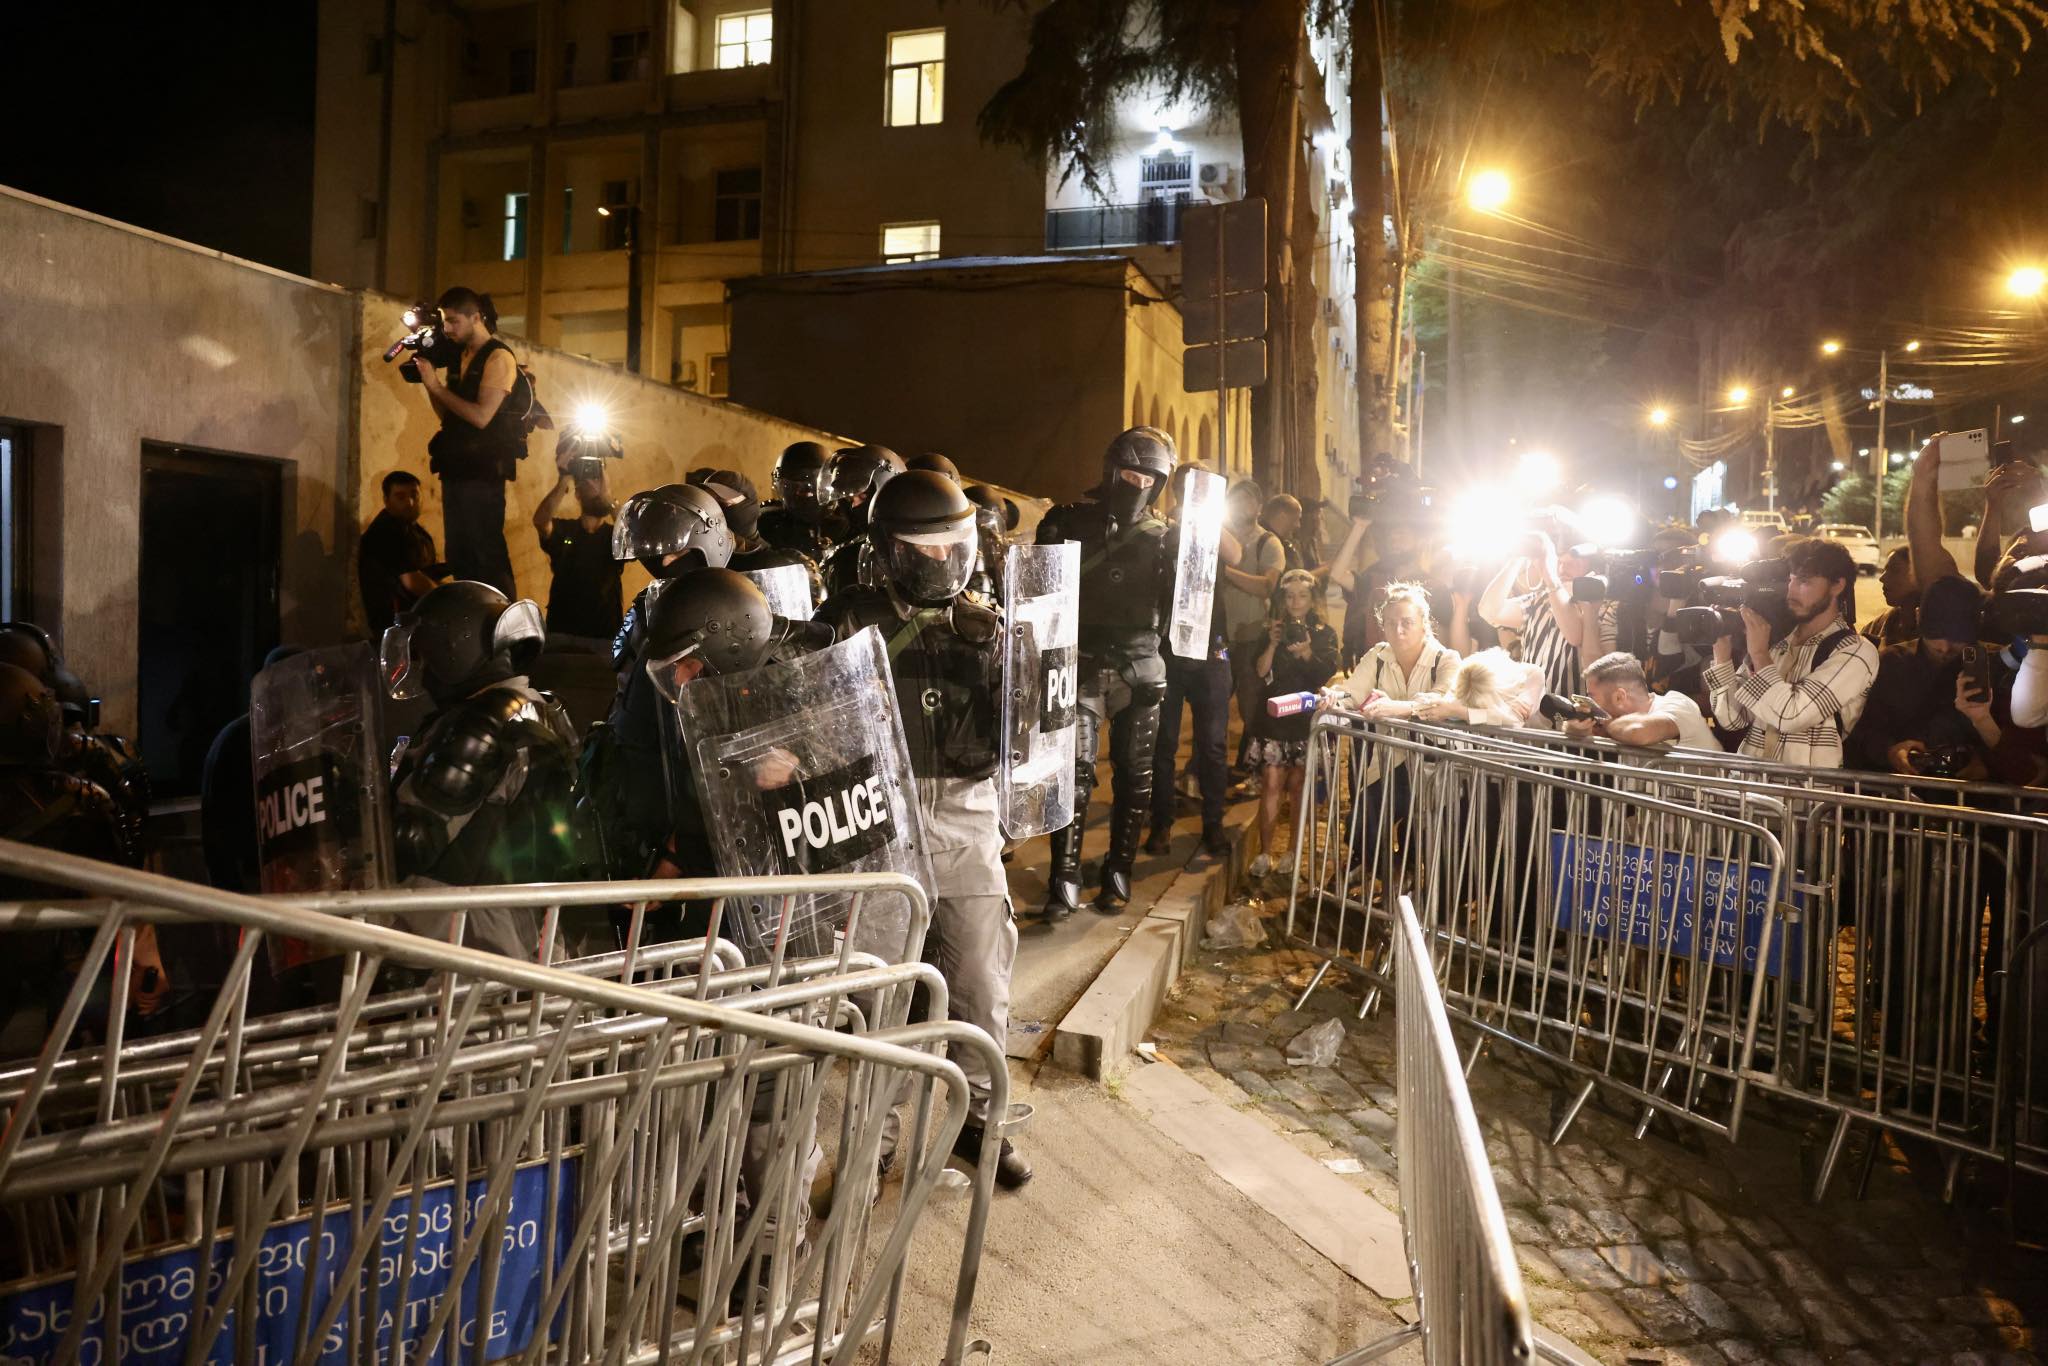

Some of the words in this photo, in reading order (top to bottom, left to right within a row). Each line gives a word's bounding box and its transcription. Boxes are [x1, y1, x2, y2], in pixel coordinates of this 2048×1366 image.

[258, 775, 326, 845] POLICE
[778, 774, 888, 858] POLICE
[1683, 912, 1737, 938] SATE
